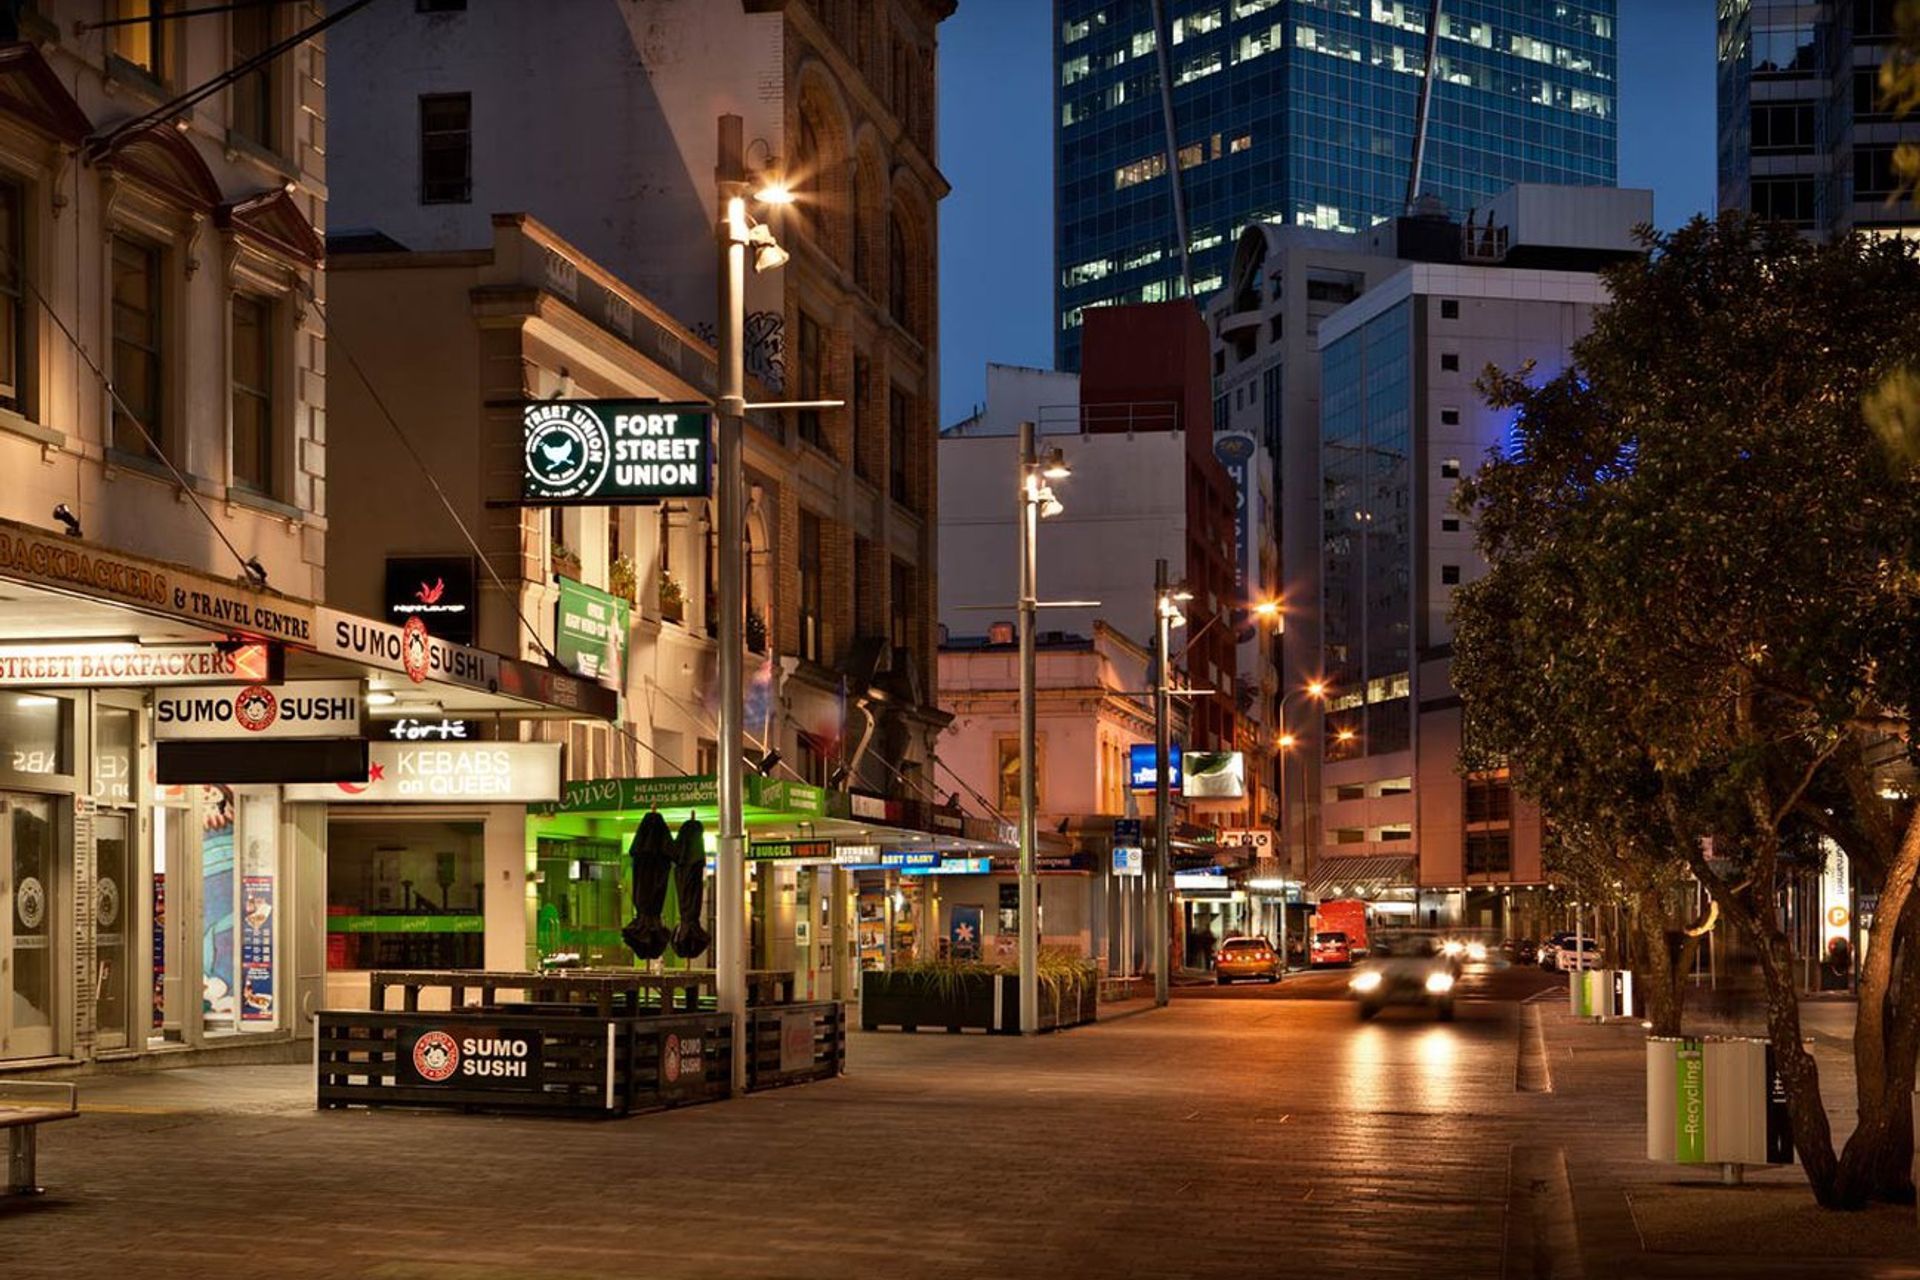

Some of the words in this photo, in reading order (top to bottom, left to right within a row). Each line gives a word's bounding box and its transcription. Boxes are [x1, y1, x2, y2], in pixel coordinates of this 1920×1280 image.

[615, 415, 678, 435] FORT
[615, 439, 699, 460] STREET
[615, 464, 697, 486] UNION
[0, 534, 167, 605] BACKPACKERS
[174, 586, 187, 610] &
[191, 592, 250, 626] TRAVEL
[254, 609, 311, 640] CENTRE
[81, 649, 236, 676] BACKPACKERS
[336, 620, 401, 663] SUMO
[430, 645, 485, 682] SUSHI
[158, 699, 232, 722] SUMO
[280, 698, 355, 720] SUSHI
[398, 751, 511, 775] KEBABS
[399, 780, 424, 794] on
[429, 775, 512, 794] QUEEN
[463, 1039, 528, 1057] SUMO
[463, 1060, 527, 1076] SUSHI
[1684, 1060, 1700, 1133] Recycling
